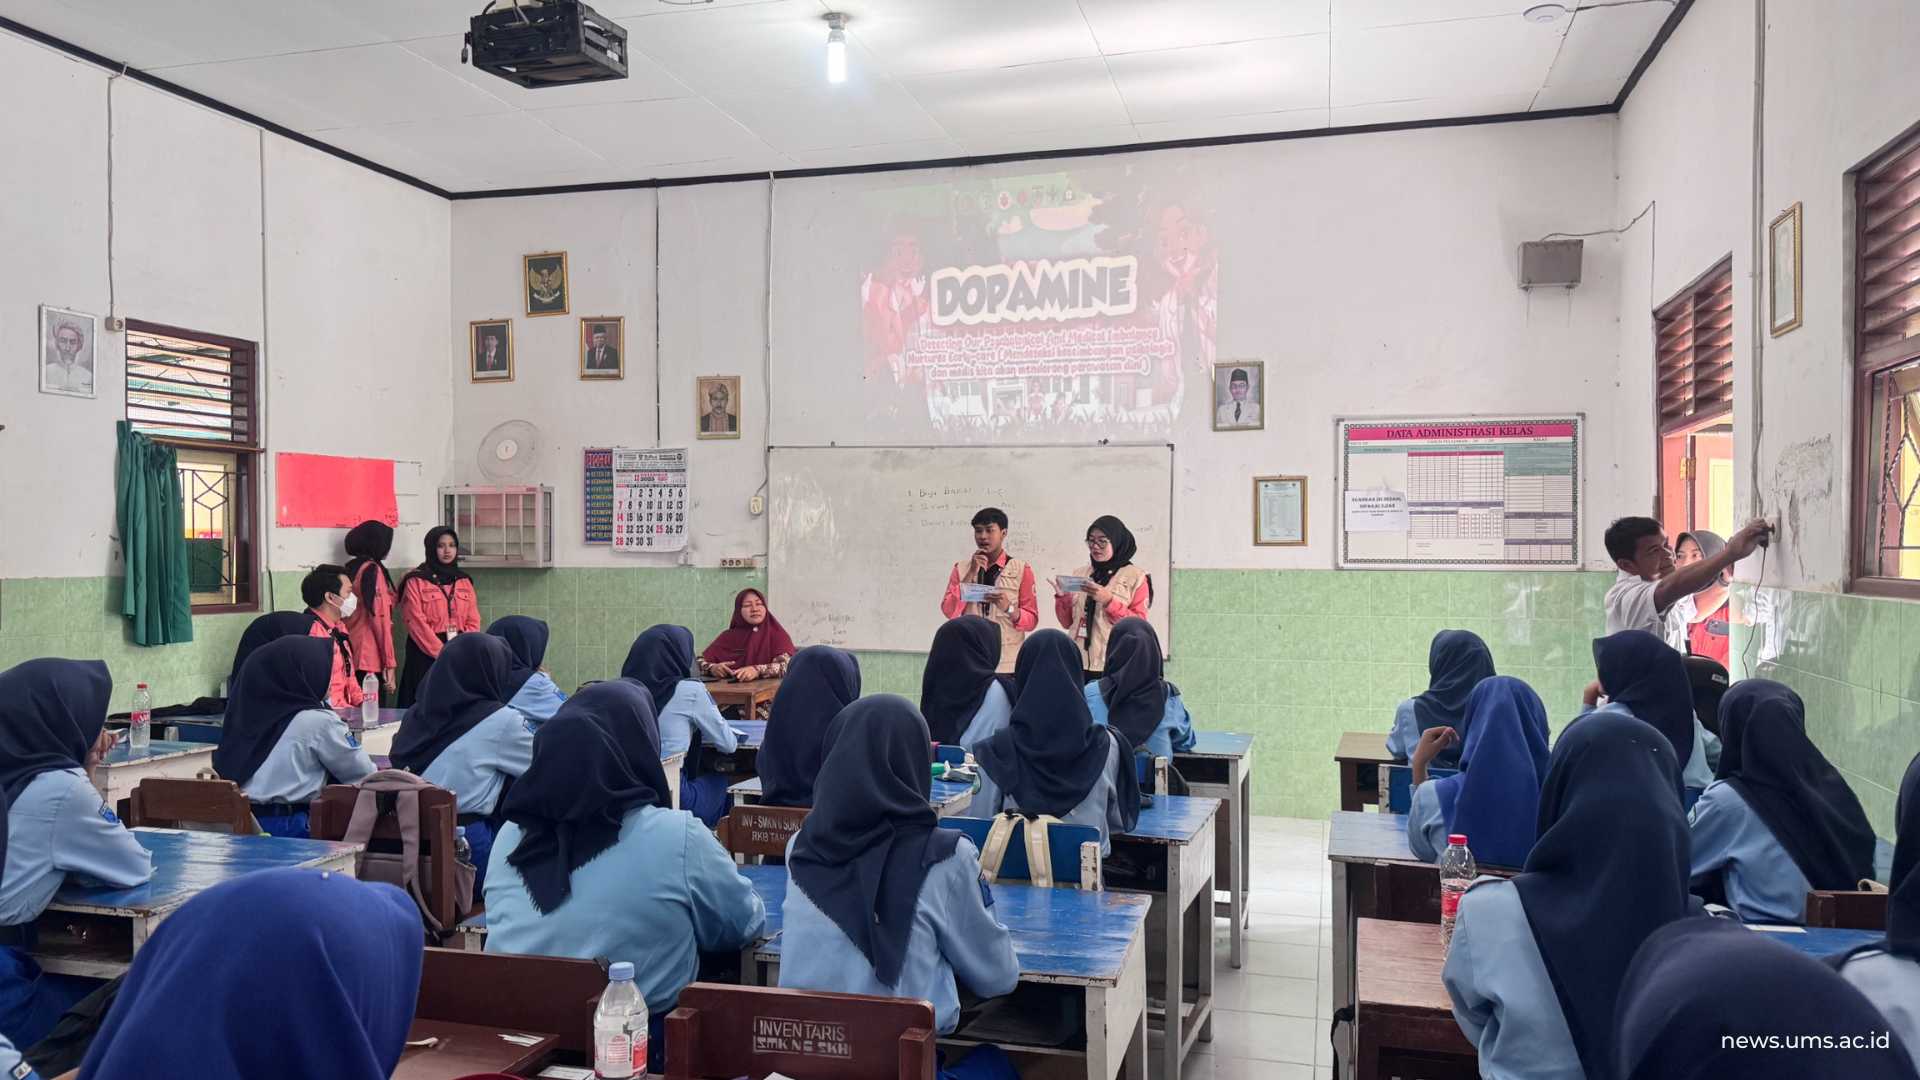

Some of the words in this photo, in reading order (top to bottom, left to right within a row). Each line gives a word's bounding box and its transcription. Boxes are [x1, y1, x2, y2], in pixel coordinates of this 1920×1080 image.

[934, 260, 1133, 321] DOPAMINE
[964, 335, 982, 348] Our
[1386, 428, 1413, 439] DATA
[1415, 426, 1496, 438] ADMINISTRASI
[1499, 425, 1534, 436] KELAS
[647, 501, 653, 510] 10
[658, 501, 662, 510] 11
[667, 501, 673, 510] 12
[677, 501, 683, 510] 13
[617, 513, 623, 522] 14
[627, 513, 633, 522] 15
[637, 513, 643, 522] 16
[647, 513, 652, 522] 17
[657, 513, 662, 522] 18
[667, 512, 672, 522] 19
[676, 513, 683, 522] 20
[626, 525, 633, 534] 22
[636, 525, 643, 534] 23
[646, 525, 653, 534] 24
[656, 525, 663, 534] 25
[666, 525, 673, 534] 26
[676, 525, 682, 534] 27
[616, 537, 623, 546] 28
[626, 537, 633, 546] 29
[636, 537, 643, 546] 30
[647, 537, 652, 546] 31
[759, 1018, 846, 1042] INVENTARIS
[757, 1036, 788, 1049] SMK
